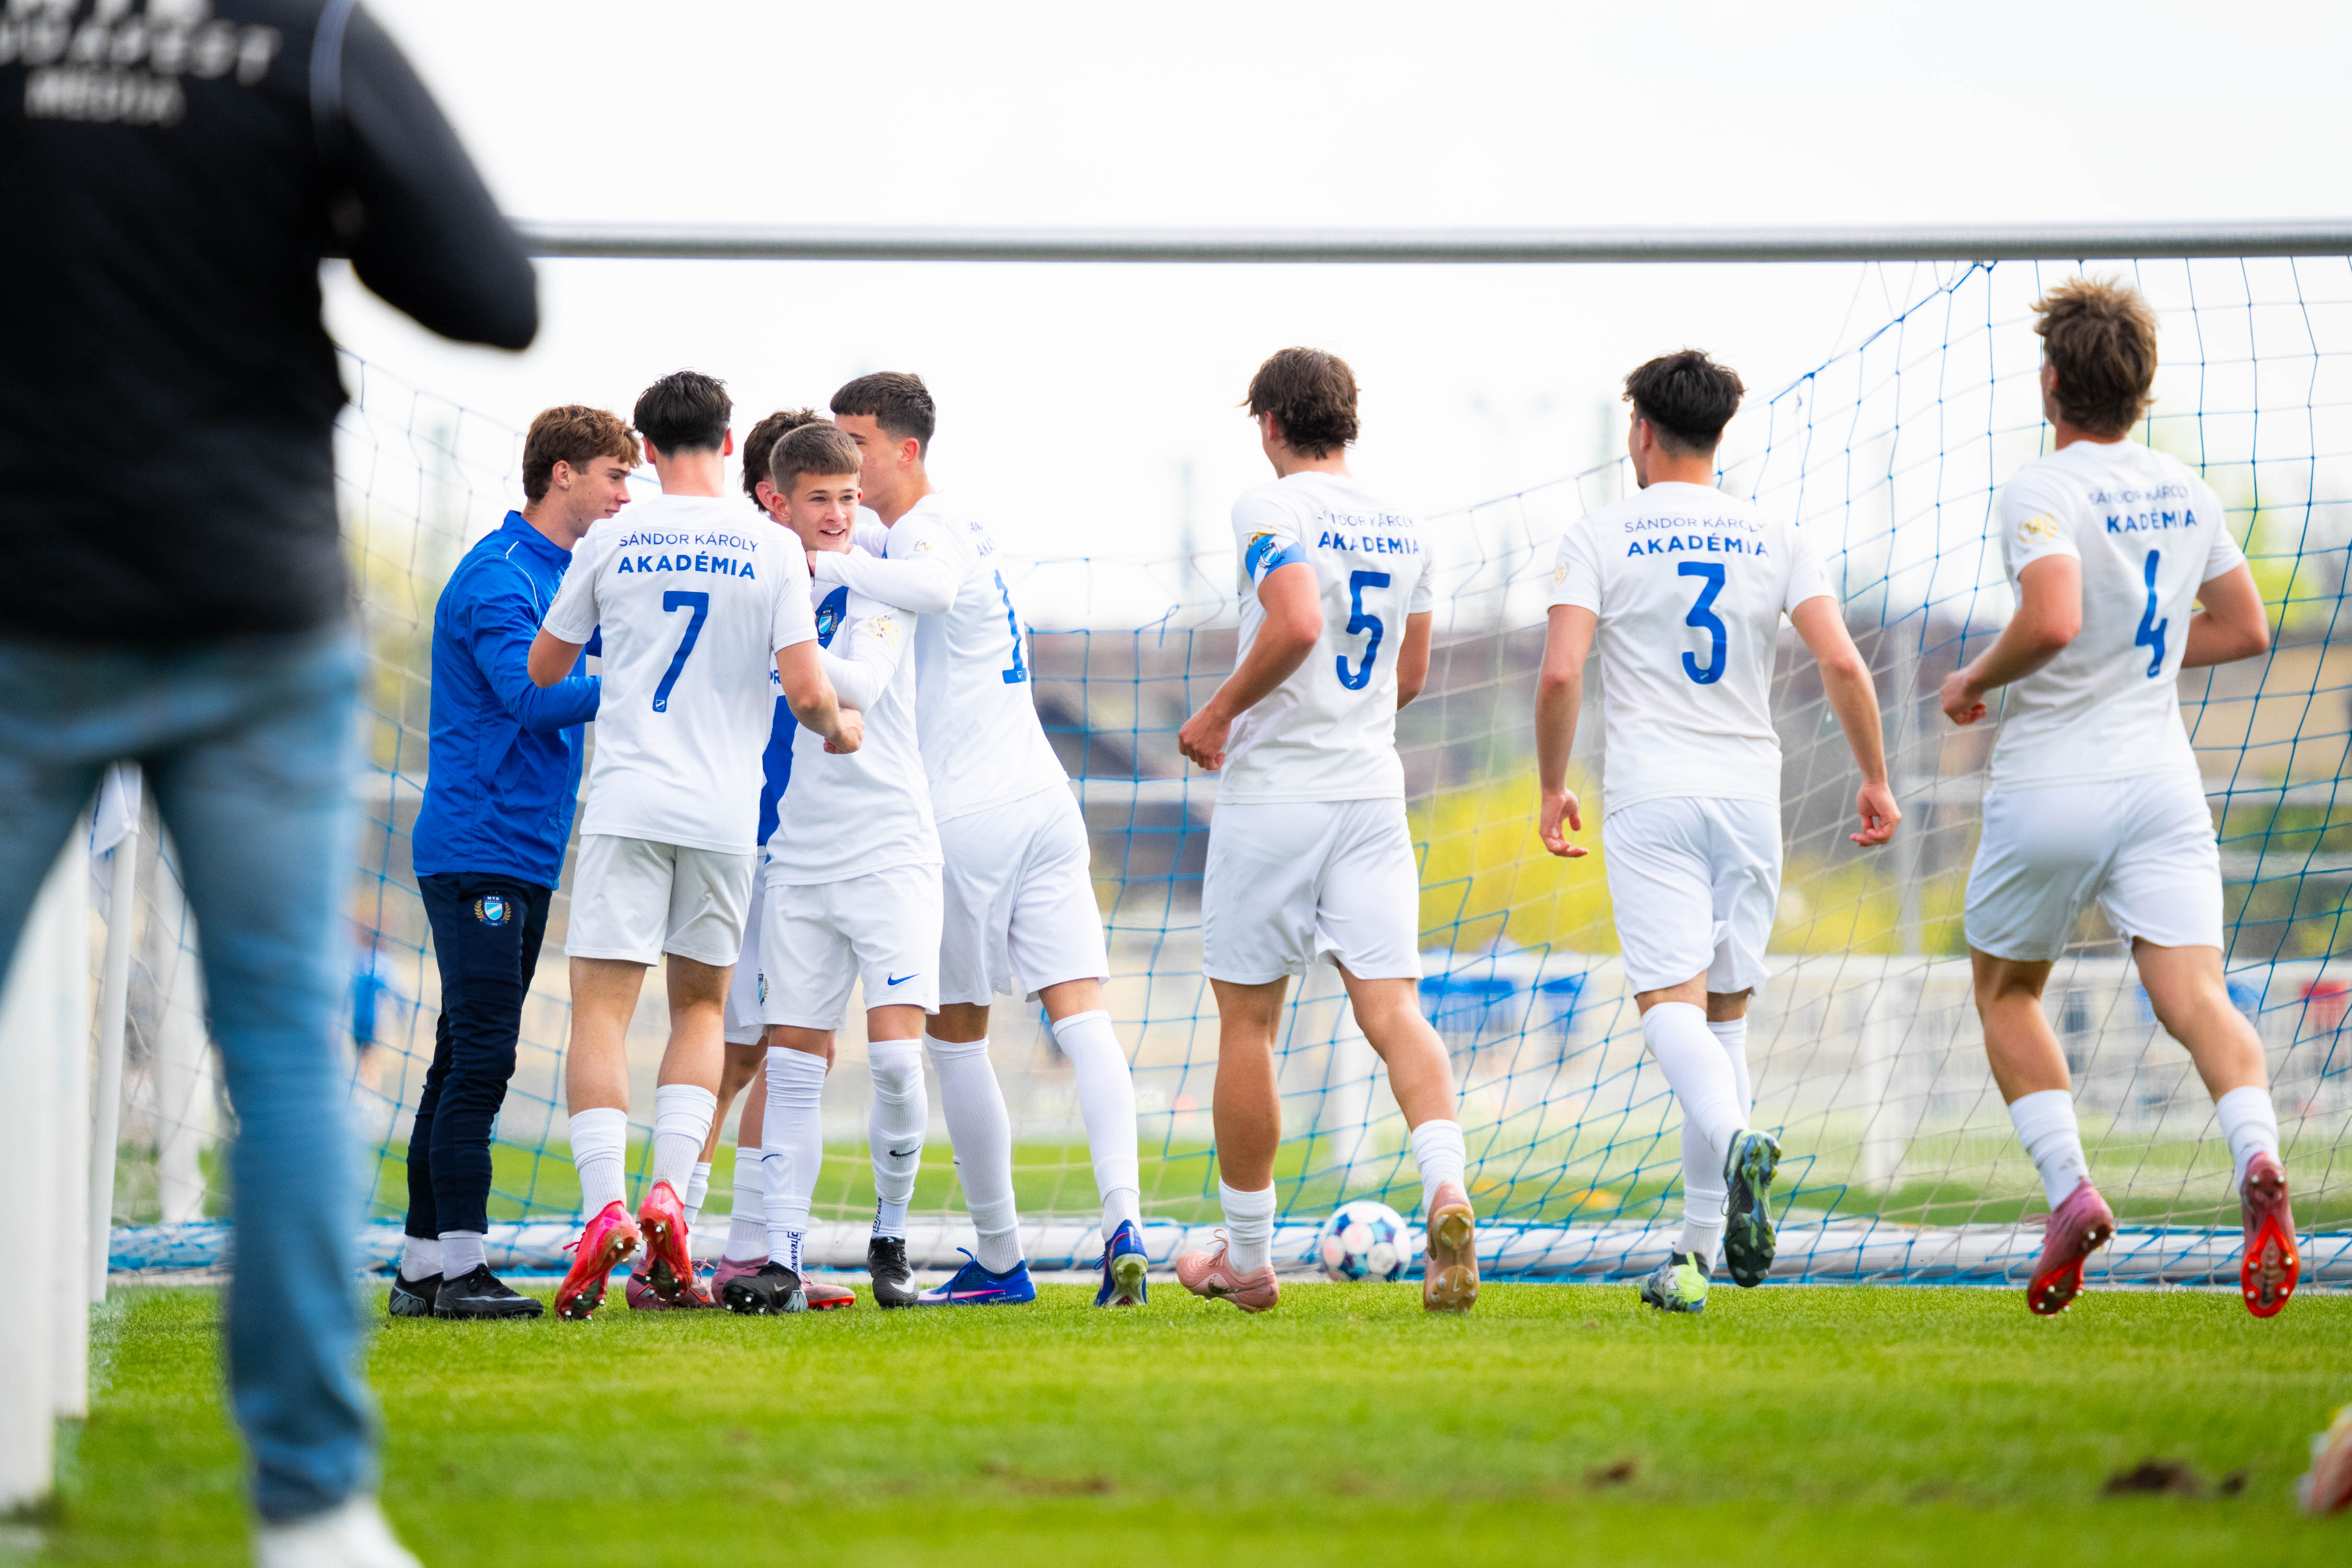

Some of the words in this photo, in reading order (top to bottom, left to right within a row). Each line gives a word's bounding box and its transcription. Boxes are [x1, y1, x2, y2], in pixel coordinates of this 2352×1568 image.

[1624, 516, 1698, 533] SÁNDOR
[1703, 516, 1767, 533] KÁROLY
[2107, 507, 2197, 534] KADÉMIA
[619, 531, 689, 547] SÁNDOR
[695, 532, 758, 552] KÁROLY
[1318, 531, 1420, 554] AKADÉMIA
[1627, 532, 1770, 557] AKADÉMIA
[617, 550, 756, 580] AKADÉMIA
[994, 569, 1028, 684] 1
[1678, 561, 1726, 685] 3
[2135, 549, 2168, 678] 4
[1336, 570, 1391, 690] 5
[652, 591, 709, 712] 7
